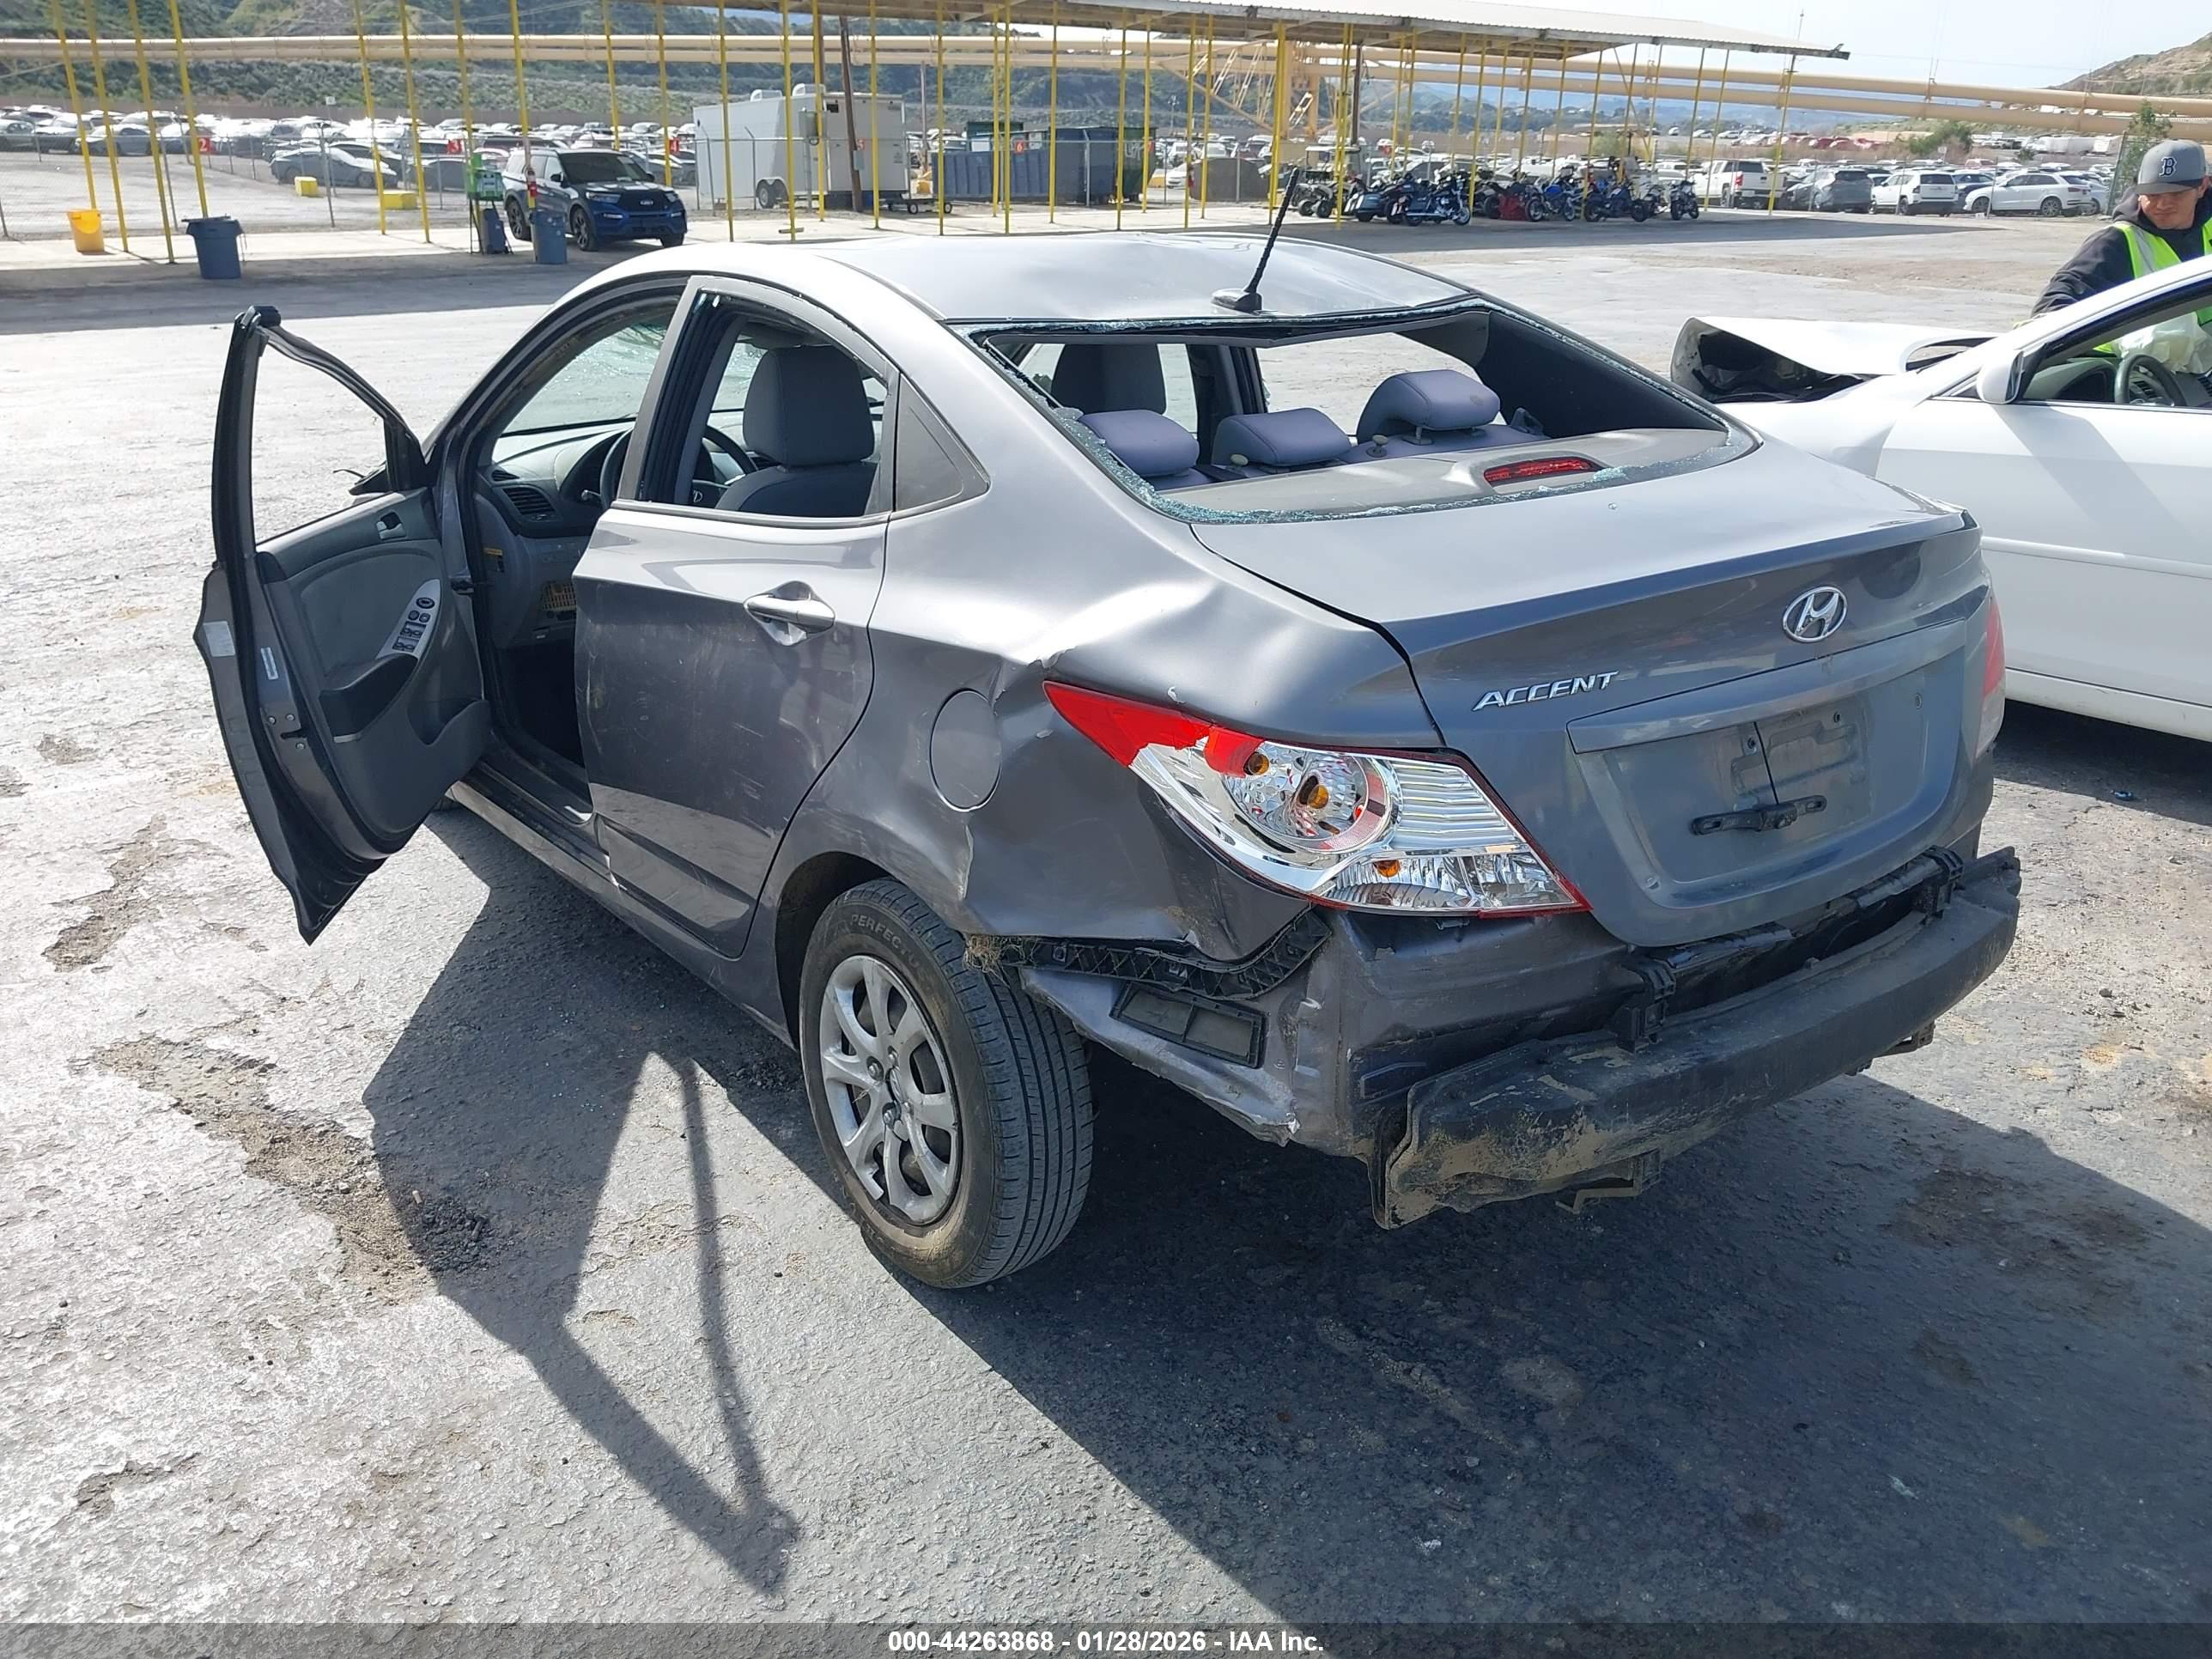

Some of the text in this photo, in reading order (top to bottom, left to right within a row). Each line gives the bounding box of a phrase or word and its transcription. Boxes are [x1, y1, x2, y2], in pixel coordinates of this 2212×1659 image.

[198, 137, 208, 152] 2
[452, 138, 459, 152] 3
[2159, 156, 2178, 177] B
[1471, 670, 1620, 712] ACCENT
